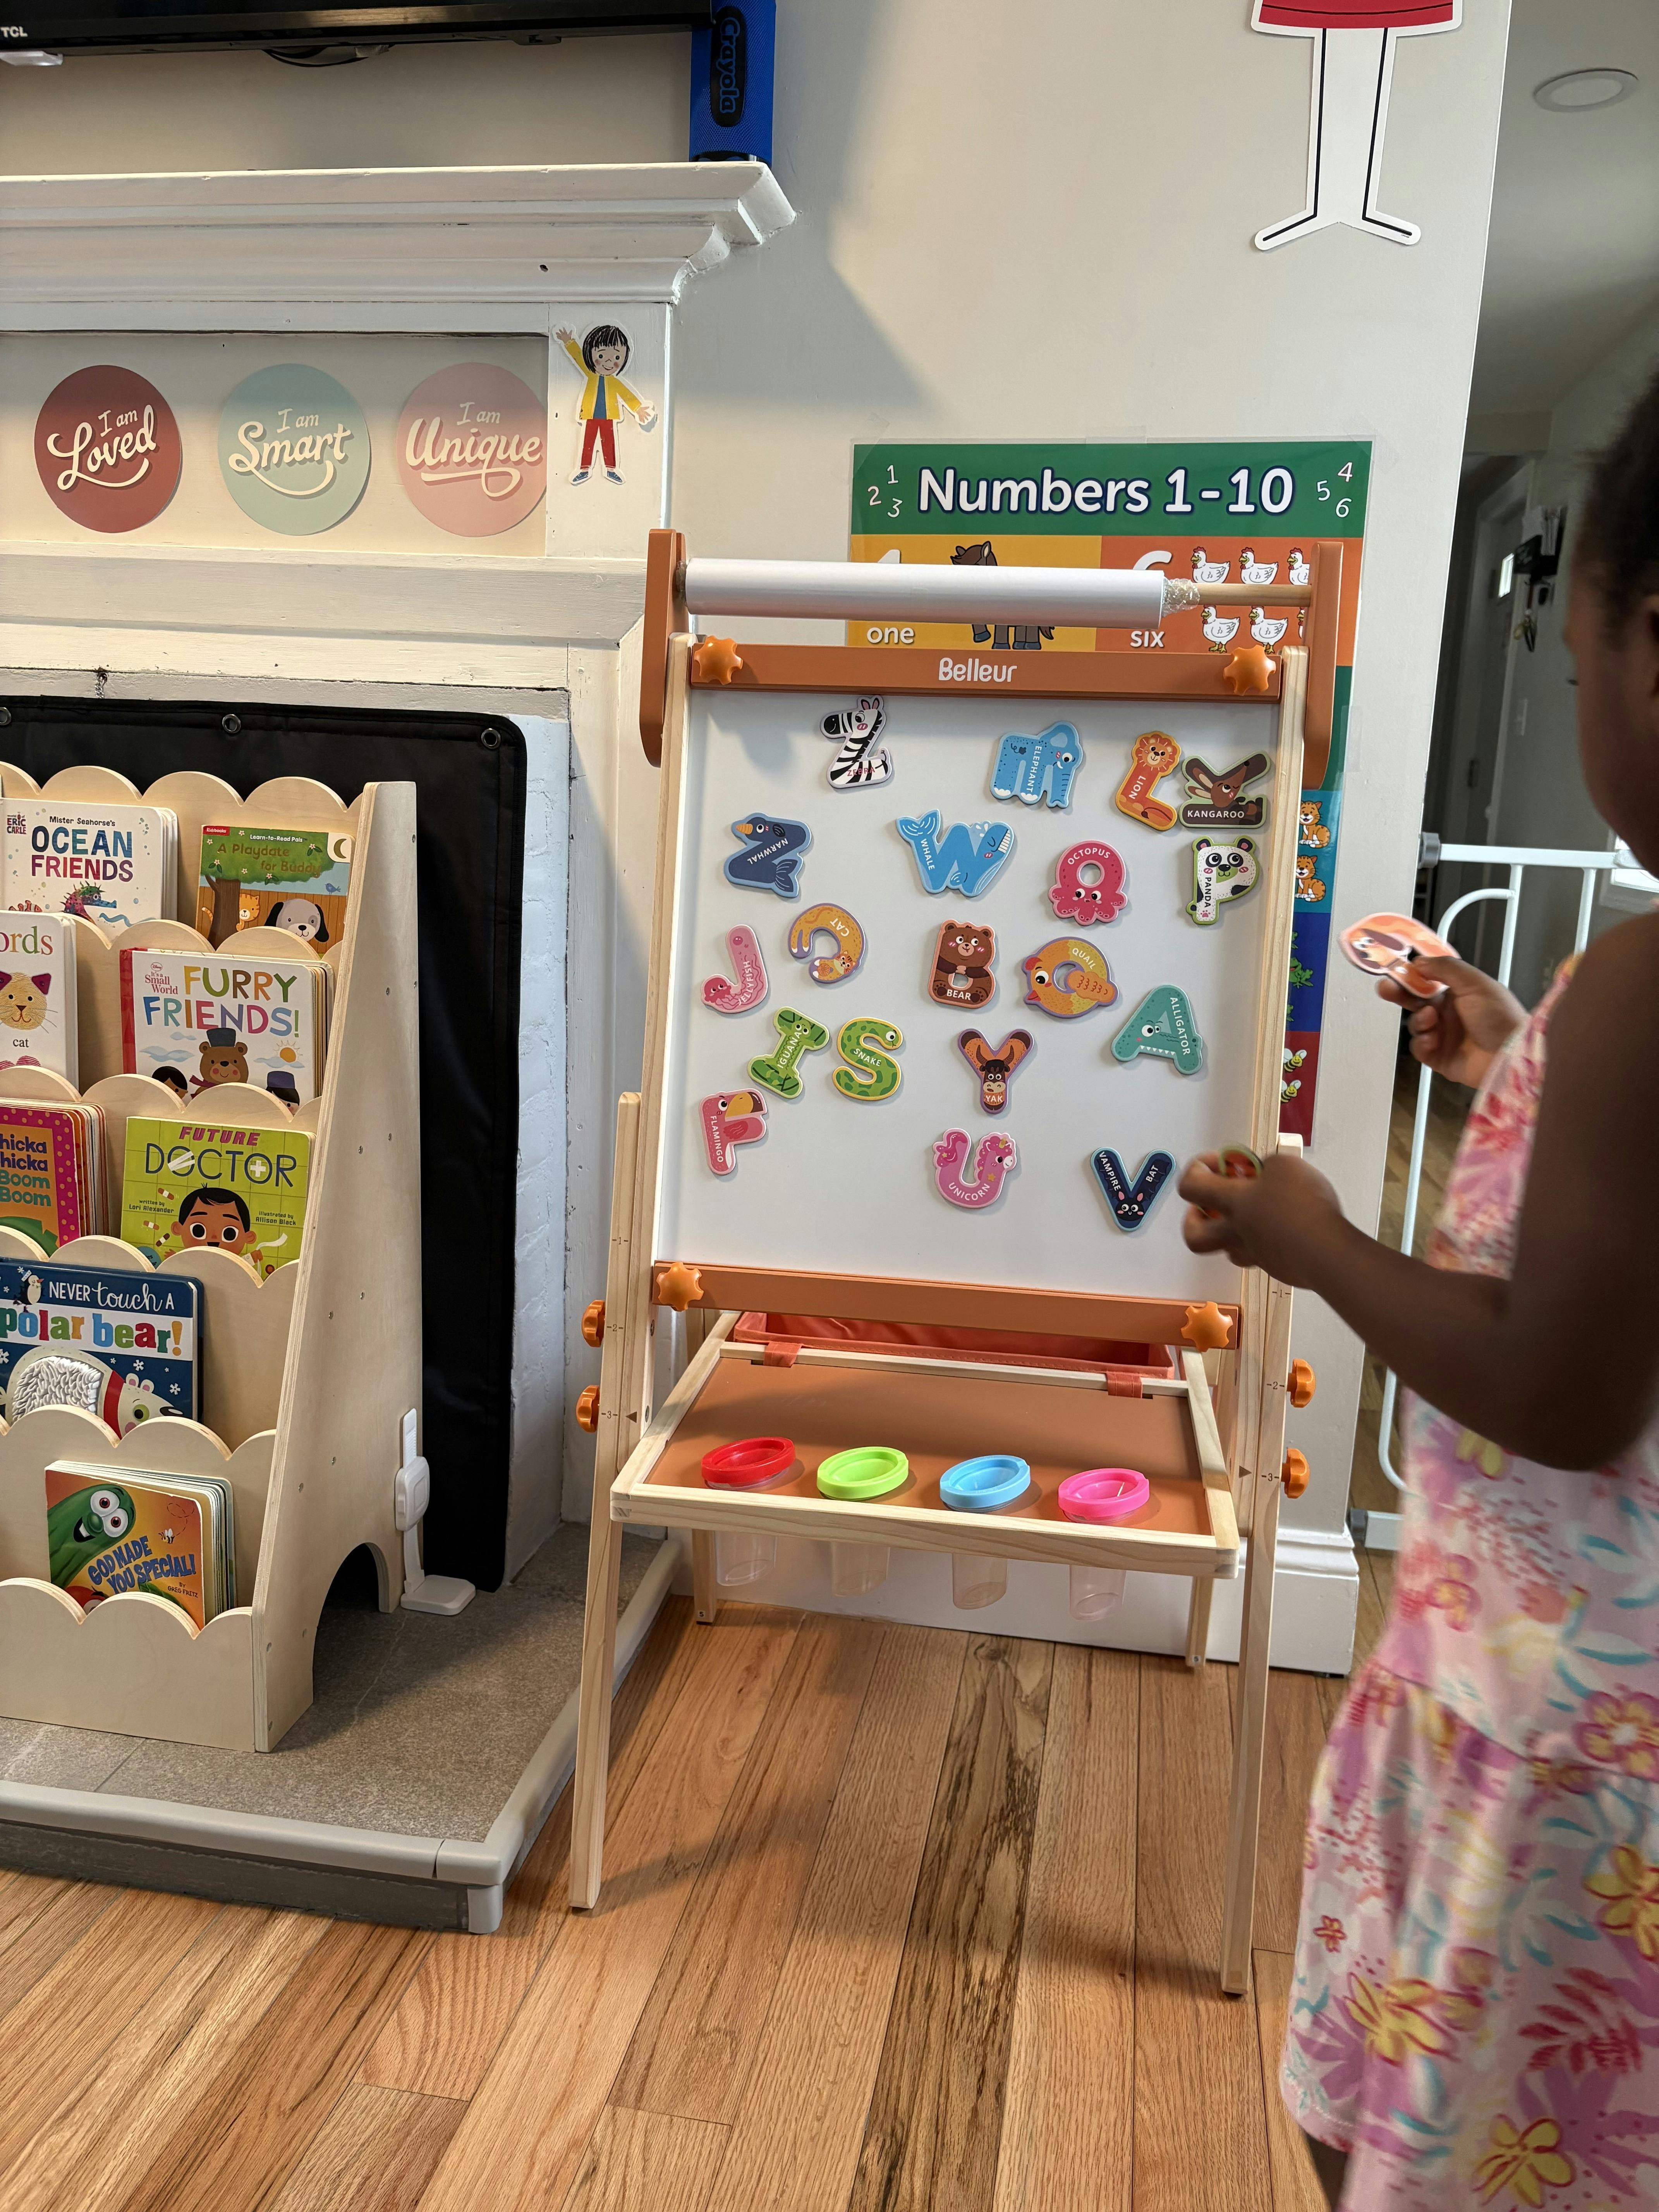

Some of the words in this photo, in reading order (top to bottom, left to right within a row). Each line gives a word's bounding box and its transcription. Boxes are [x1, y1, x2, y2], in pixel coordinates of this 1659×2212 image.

[0, 26, 28, 38] TCL
[716, 17, 740, 113] Crayola
[98, 410, 112, 436] I
[116, 409, 138, 428] am
[276, 408, 293, 433] I
[295, 414, 319, 428] am
[456, 402, 475, 426] I
[476, 411, 500, 424] am
[46, 404, 157, 491] Loved
[228, 421, 352, 495] Smart
[405, 416, 543, 498] Unique
[887, 465, 899, 484] 1
[1338, 462, 1353, 482] 4
[867, 486, 882, 506] 2
[918, 466, 1150, 515] Numbers
[1164, 466, 1294, 515] 1-10
[1317, 480, 1330, 501] 5
[887, 498, 903, 518] 3
[1336, 498, 1352, 517] 6
[867, 627, 915, 644] one
[1130, 631, 1164, 647] six
[938, 657, 1018, 682] Belleur
[847, 767, 876, 776] ZEBRA
[1026, 745, 1042, 792] ELEPHANT
[1128, 775, 1147, 800] LION
[77, 817, 115, 826] Seahorse's
[1187, 810, 1245, 819] KANGAROO
[7, 826, 26, 834] CARLE
[31, 825, 132, 858] OCEAN
[217, 843, 227, 854] A
[232, 843, 289, 859] Playdate
[747, 838, 789, 865] NARWHAL
[920, 838, 935, 871] WHALE
[1067, 847, 1111, 865] OCTOPUS
[31, 855, 134, 882] FRIENDS
[261, 860, 276, 871] for
[281, 861, 321, 878] Buddy
[1204, 877, 1212, 908] PANDA
[830, 917, 850, 937] CAT
[0, 926, 53, 955] ords
[1071, 947, 1096, 970] QUAIL
[145, 975, 170, 985] Small
[151, 984, 178, 994] World
[184, 965, 297, 1003] FURRY
[737, 960, 753, 1006] JELLYFISH
[946, 989, 971, 1001] BEAR
[143, 996, 299, 1038] FRIENDS!
[1169, 996, 1191, 1056] ALLIGATOR
[13, 1038, 29, 1048] cat
[777, 1031, 802, 1069] IGUANA
[853, 1048, 882, 1067] SNAKE
[985, 1094, 1003, 1103] YAK
[0, 1133, 47, 1154] hicka
[179, 1126, 261, 1146] FUTURE
[710, 1115, 724, 1163] FLAMINGO
[0, 1151, 48, 1172] hicka
[145, 1142, 297, 1187] DOCTOR
[1098, 1151, 1121, 1192] VAMPIRE
[1146, 1164, 1159, 1183] BAT
[0, 1170, 50, 1189] Boom
[0, 1186, 52, 1206] Boom
[948, 1182, 991, 1202] UNICORN
[49, 1281, 90, 1302] NEVER
[91, 1281, 162, 1312] touch
[165, 1293, 175, 1310] A
[0, 1307, 85, 1341] polar
[92, 1313, 183, 1356] bear!
[88, 1554, 115, 1585] GOD
[112, 1535, 153, 1568] MADE
[106, 1568, 135, 1595] YOU
[134, 1554, 196, 1583] SPECIAL!
[182, 1589, 198, 1597] FRITZ
